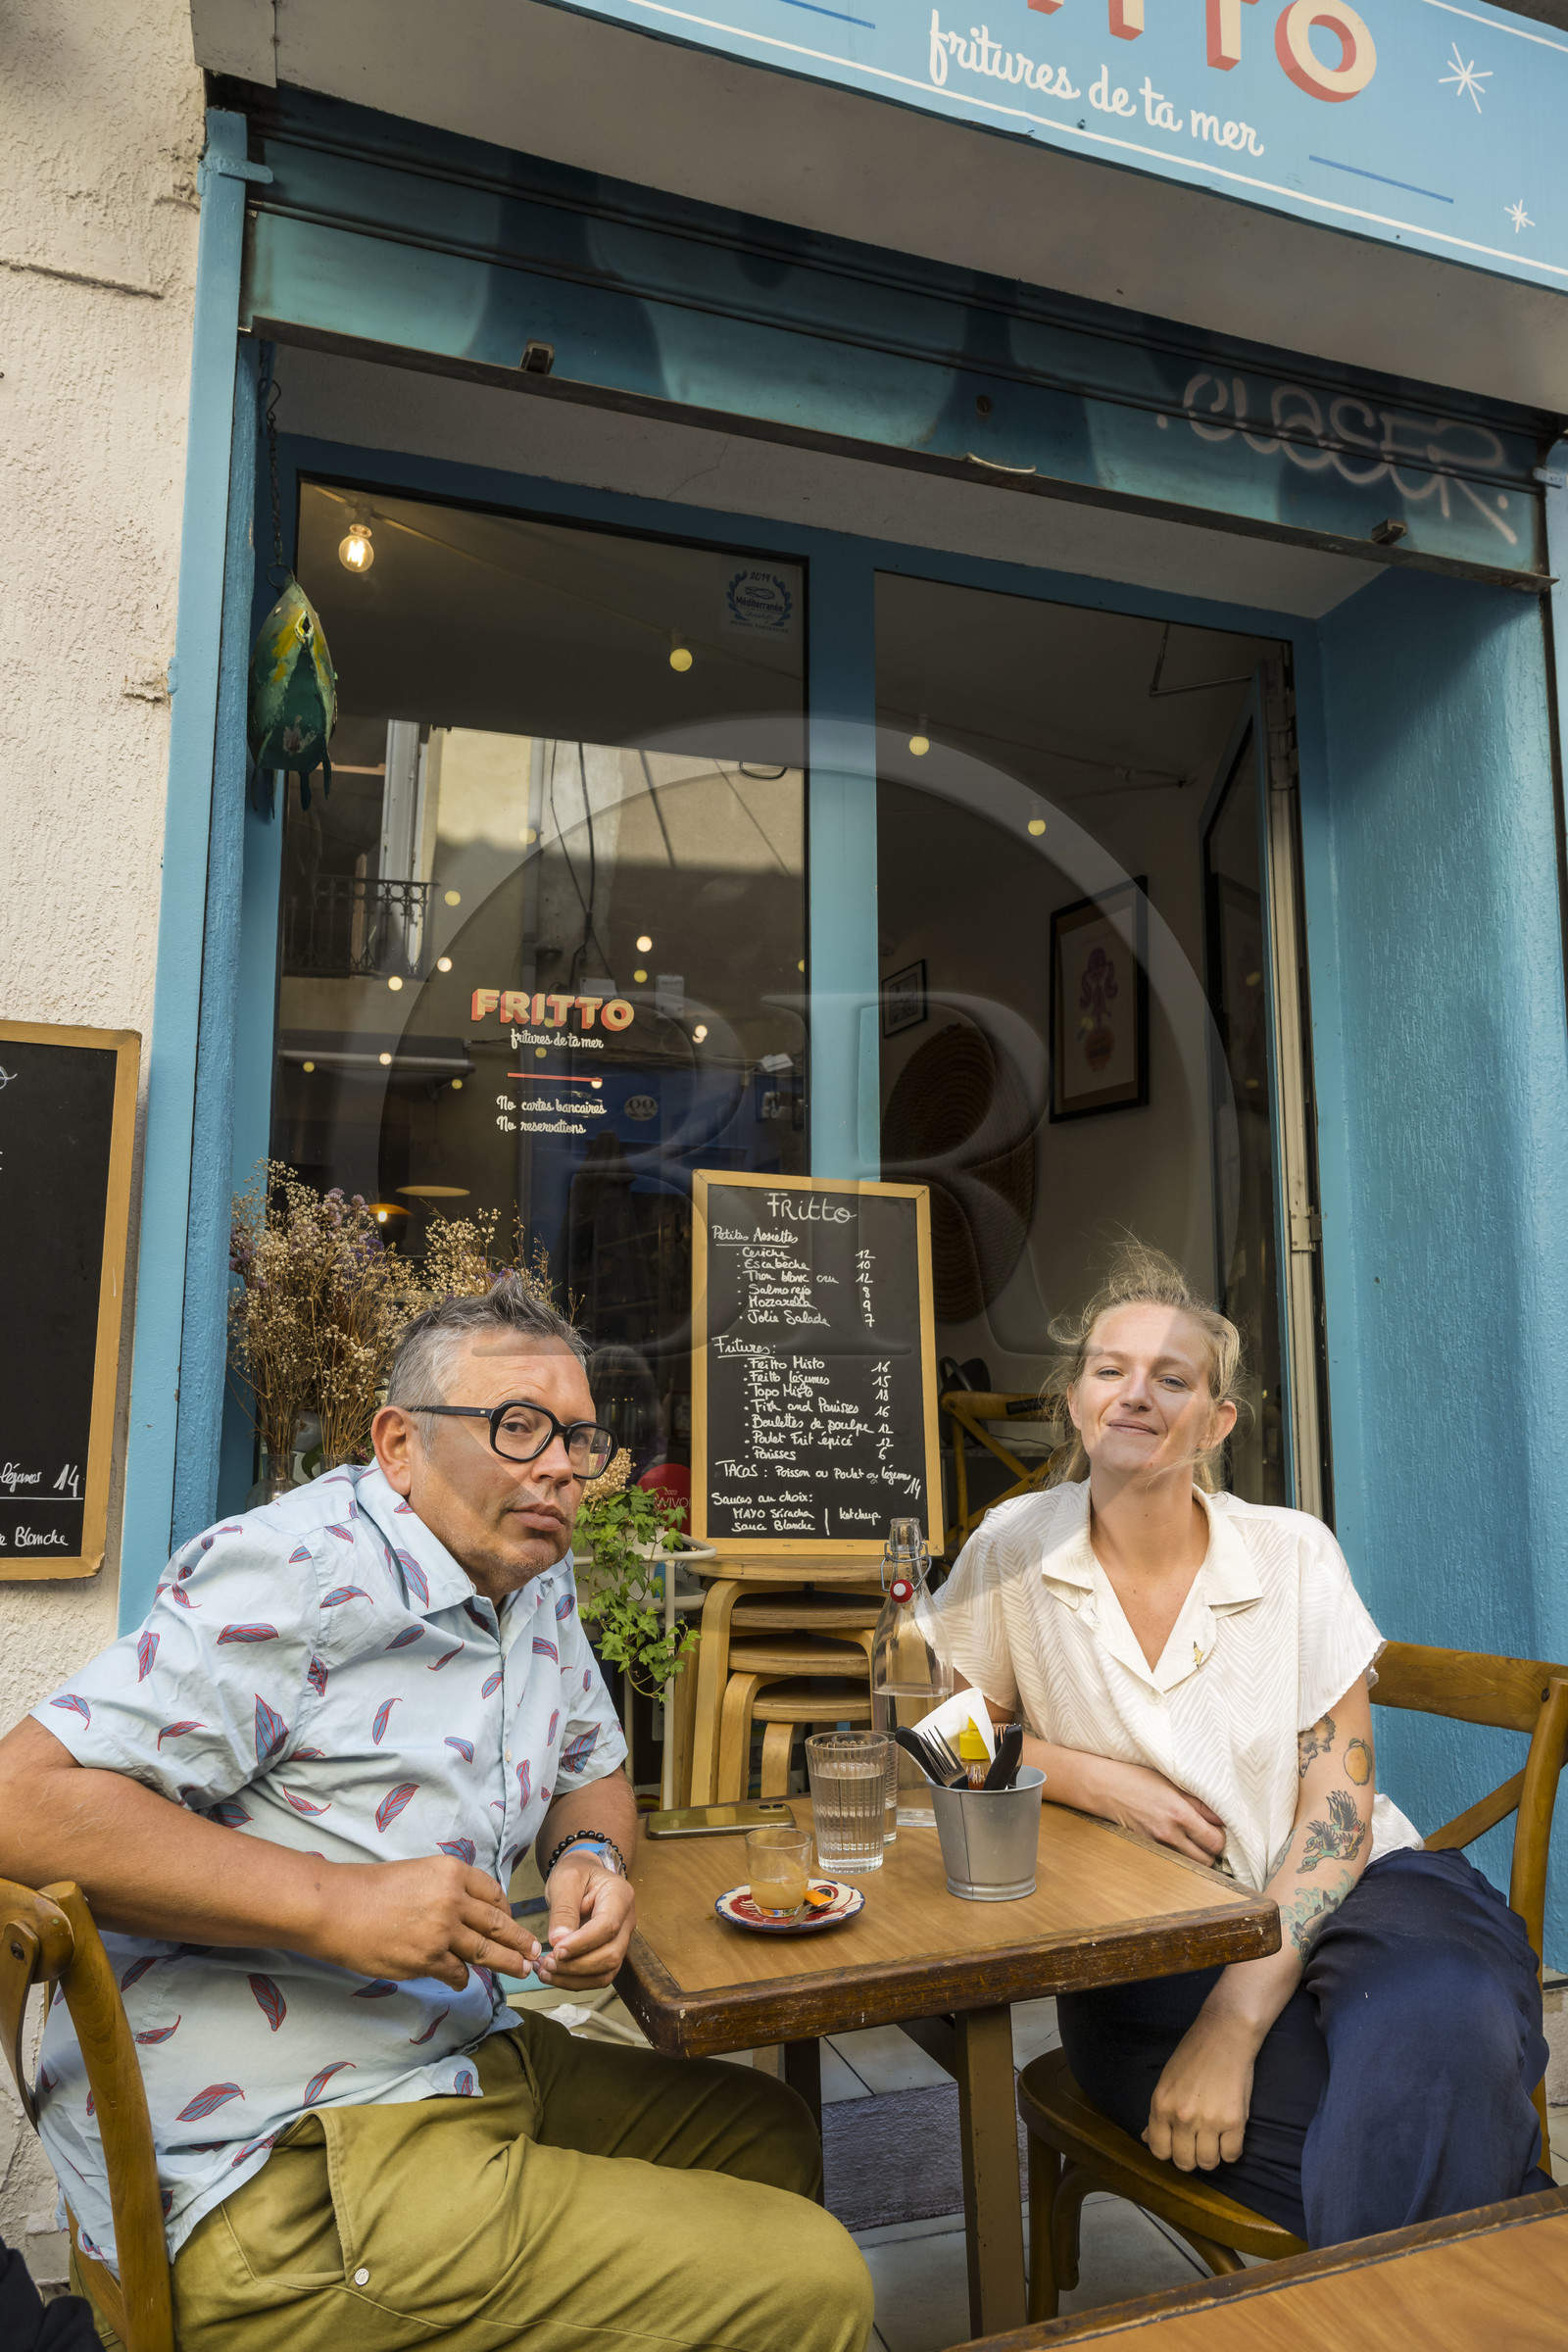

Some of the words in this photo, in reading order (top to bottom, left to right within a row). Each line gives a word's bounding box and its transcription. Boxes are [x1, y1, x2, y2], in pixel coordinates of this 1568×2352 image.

[928, 8, 1081, 99] fritures
[1088, 64, 1137, 117] de
[1138, 75, 1184, 132] ta
[1190, 108, 1265, 157] mer
[749, 571, 771, 582] 2019
[470, 988, 635, 1032] FRITTO
[511, 1028, 553, 1049] fritures
[553, 1031, 567, 1047] de
[567, 1032, 581, 1048] ta
[581, 1038, 605, 1049] mer
[496, 1095, 516, 1111] No
[521, 1098, 555, 1112] cartes
[555, 1099, 608, 1114] bancaires
[496, 1115, 516, 1132] No
[520, 1119, 587, 1135] reservations
[711, 1225, 750, 1241] Petites
[753, 1227, 799, 1244] Assiettes
[856, 1250, 876, 1259] 12
[856, 1261, 871, 1270] 10
[742, 1270, 776, 1282] Thon
[781, 1270, 810, 1283] blanc
[816, 1274, 840, 1284] cru
[856, 1273, 874, 1283] 12
[862, 1287, 870, 1298] 8
[748, 1296, 818, 1310] Mozzarella
[862, 1300, 871, 1312] 9
[747, 1310, 780, 1324] Jolie
[783, 1310, 831, 1327] Salade
[864, 1314, 875, 1328] 7
[793, 1355, 825, 1369] Misto
[871, 1361, 891, 1373] 16
[872, 1375, 892, 1388] 15
[747, 1383, 780, 1400] Topo
[875, 1389, 889, 1401] 18
[750, 1398, 781, 1413] Fish
[787, 1400, 813, 1412] and
[875, 1405, 891, 1418] 16
[751, 1413, 804, 1429] Boulettes
[810, 1417, 825, 1430] de
[827, 1419, 874, 1437] poulpe
[878, 1423, 895, 1434] 12
[752, 1430, 787, 1445] Poulet
[790, 1431, 814, 1446] Frit
[817, 1431, 853, 1449] épicé
[876, 1438, 895, 1447] 12
[878, 1446, 888, 1460] 6
[53, 1463, 79, 1497] 14
[774, 1465, 811, 1478] Poisson
[833, 1467, 865, 1480] Poulet
[904, 1477, 922, 1500] 14
[711, 1492, 753, 1506] Sauces
[758, 1494, 776, 1503] au
[733, 1508, 765, 1519] MAYO
[773, 1519, 816, 1532] Blanche
[15, 1526, 70, 1547] Blanche
